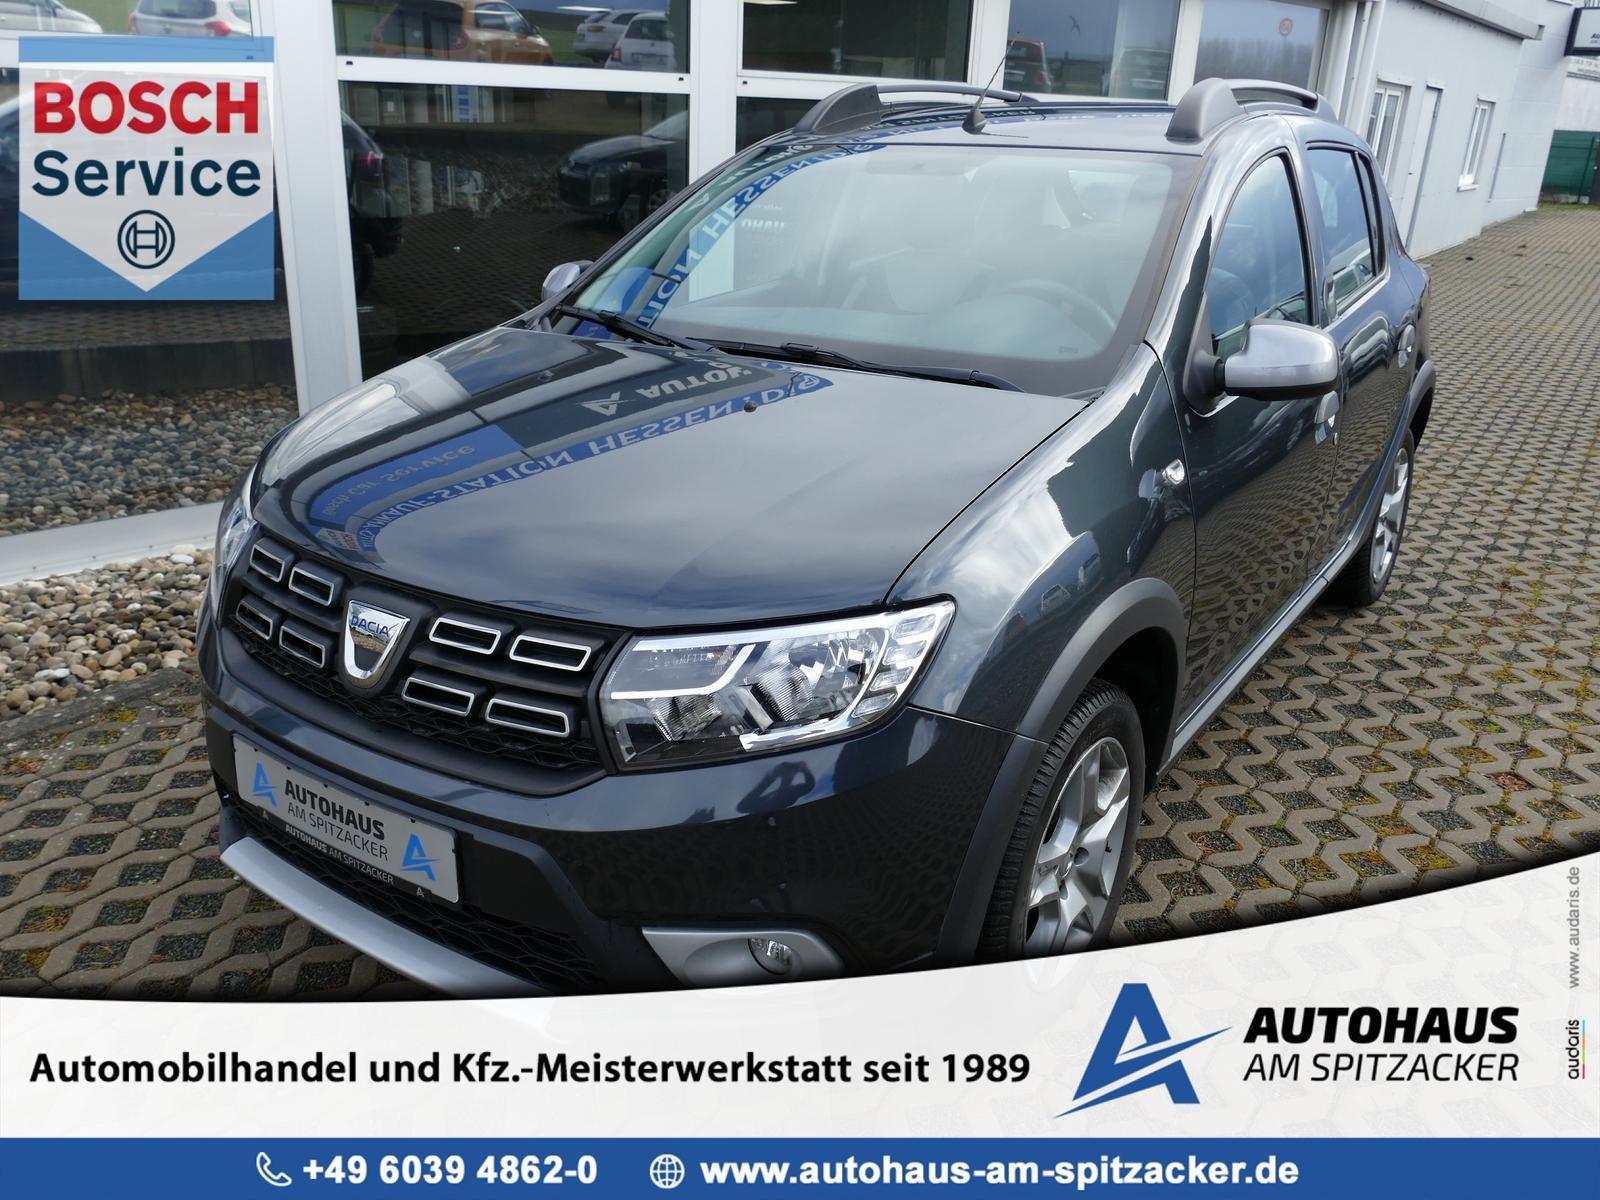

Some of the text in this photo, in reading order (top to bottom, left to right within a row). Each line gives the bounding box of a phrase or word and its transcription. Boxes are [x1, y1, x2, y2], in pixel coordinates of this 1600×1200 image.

[350, 614, 391, 637] DACIA
[284, 779, 386, 842] AUTOHAUS
[287, 802, 389, 862] AM SPITZACKER
[284, 824, 395, 886] AUTOHAUS AM SPITZACKER
